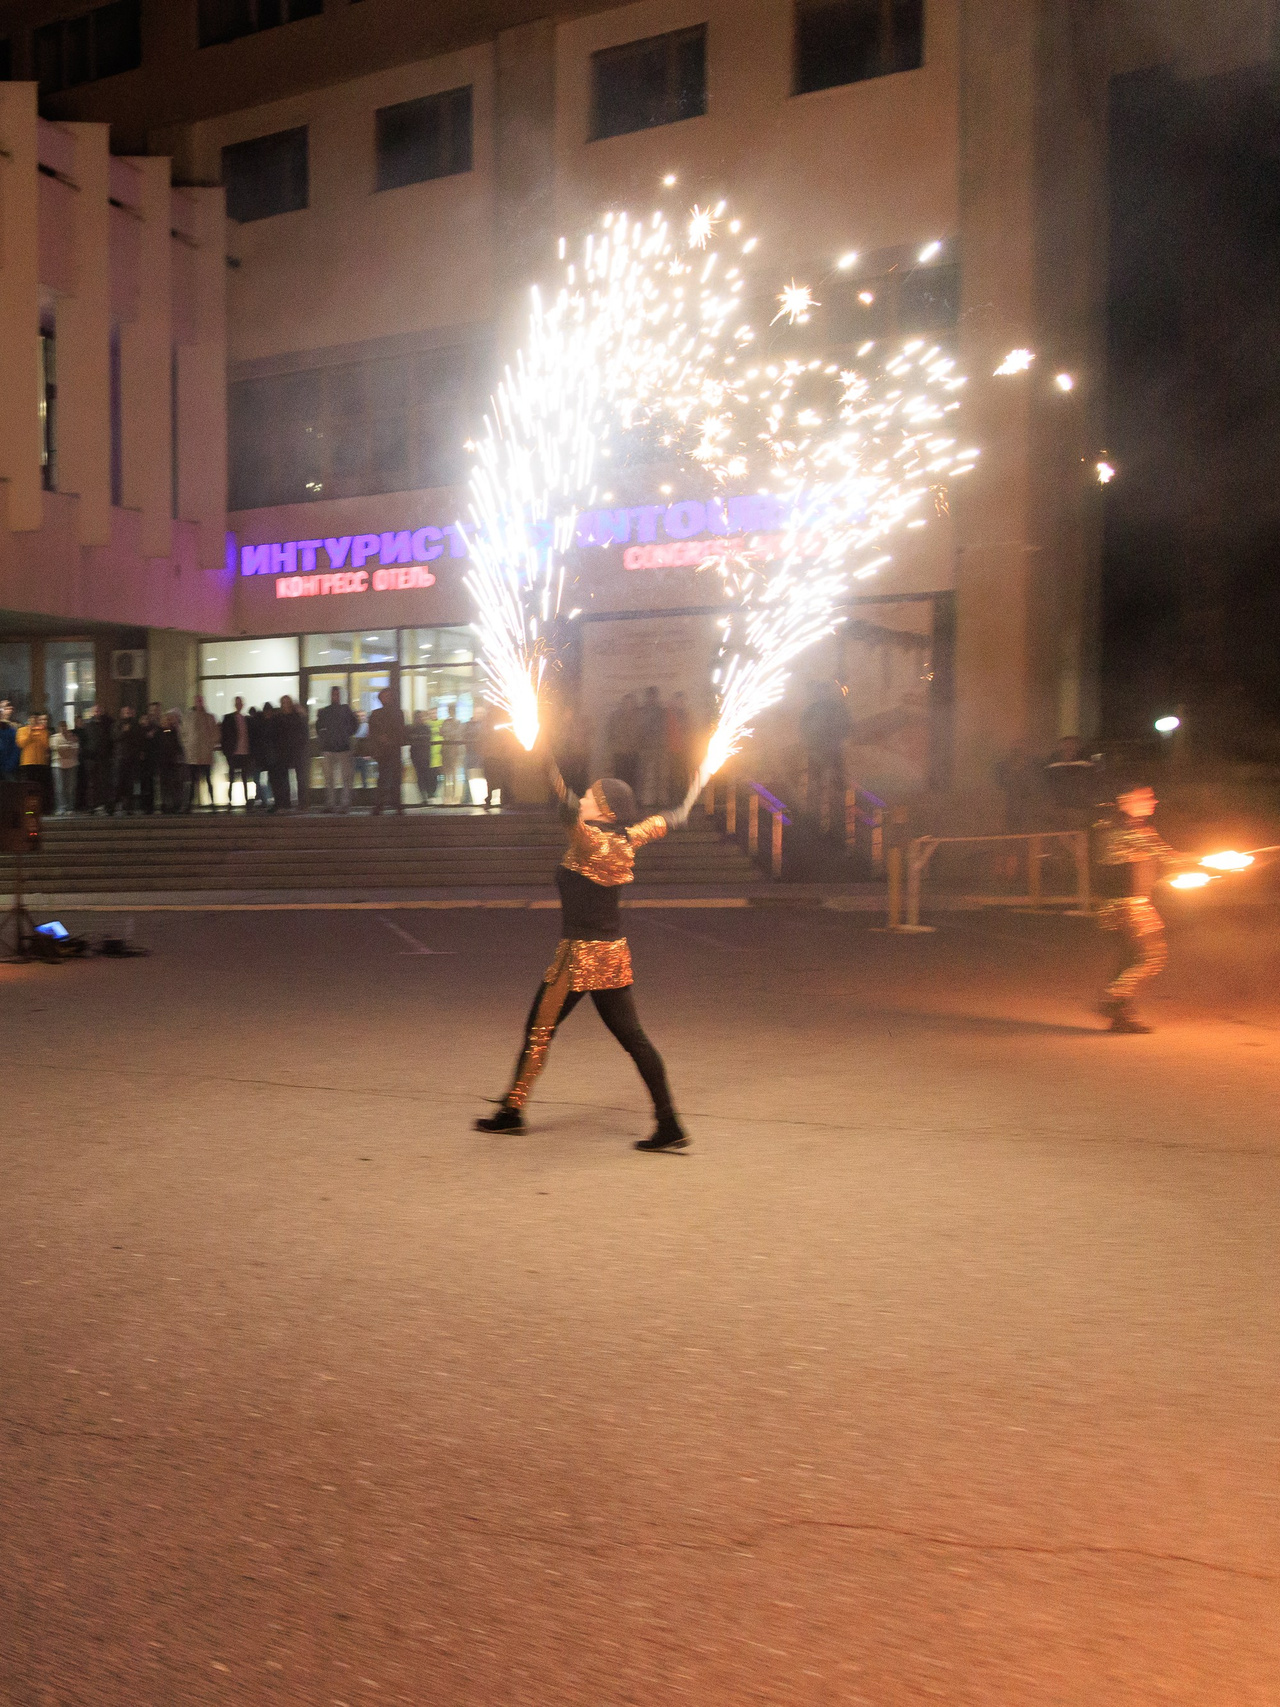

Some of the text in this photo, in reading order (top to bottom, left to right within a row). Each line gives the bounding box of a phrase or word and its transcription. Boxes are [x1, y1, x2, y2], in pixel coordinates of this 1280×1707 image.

[241, 526, 477, 577] ИНТУРИСТ
[276, 566, 436, 598] КОНГРЕСС ОТЕЛЬ
